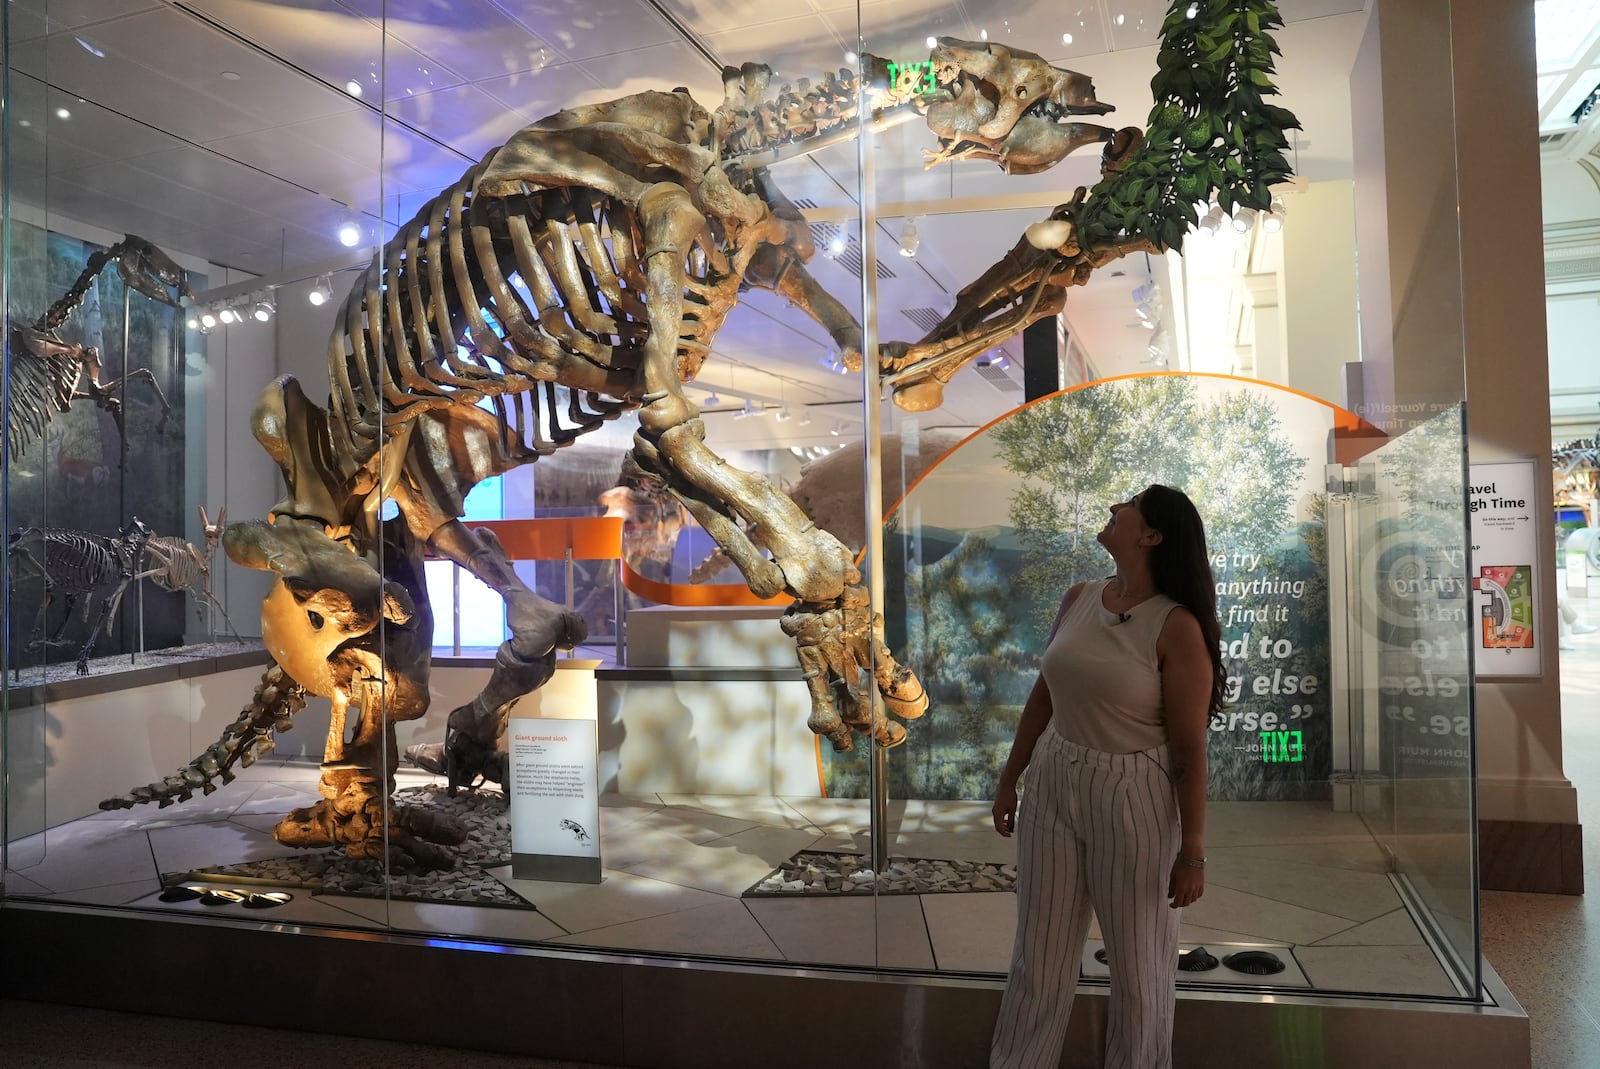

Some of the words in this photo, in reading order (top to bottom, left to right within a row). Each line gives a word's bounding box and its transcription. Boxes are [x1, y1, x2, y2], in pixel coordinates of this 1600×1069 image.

[1491, 497, 1526, 509] Time
[1233, 552, 1261, 571] try
[1215, 577, 1305, 599] anything
[1225, 605, 1269, 628] find
[1275, 605, 1289, 622] it
[1259, 636, 1292, 659] to
[1252, 668, 1318, 695] else
